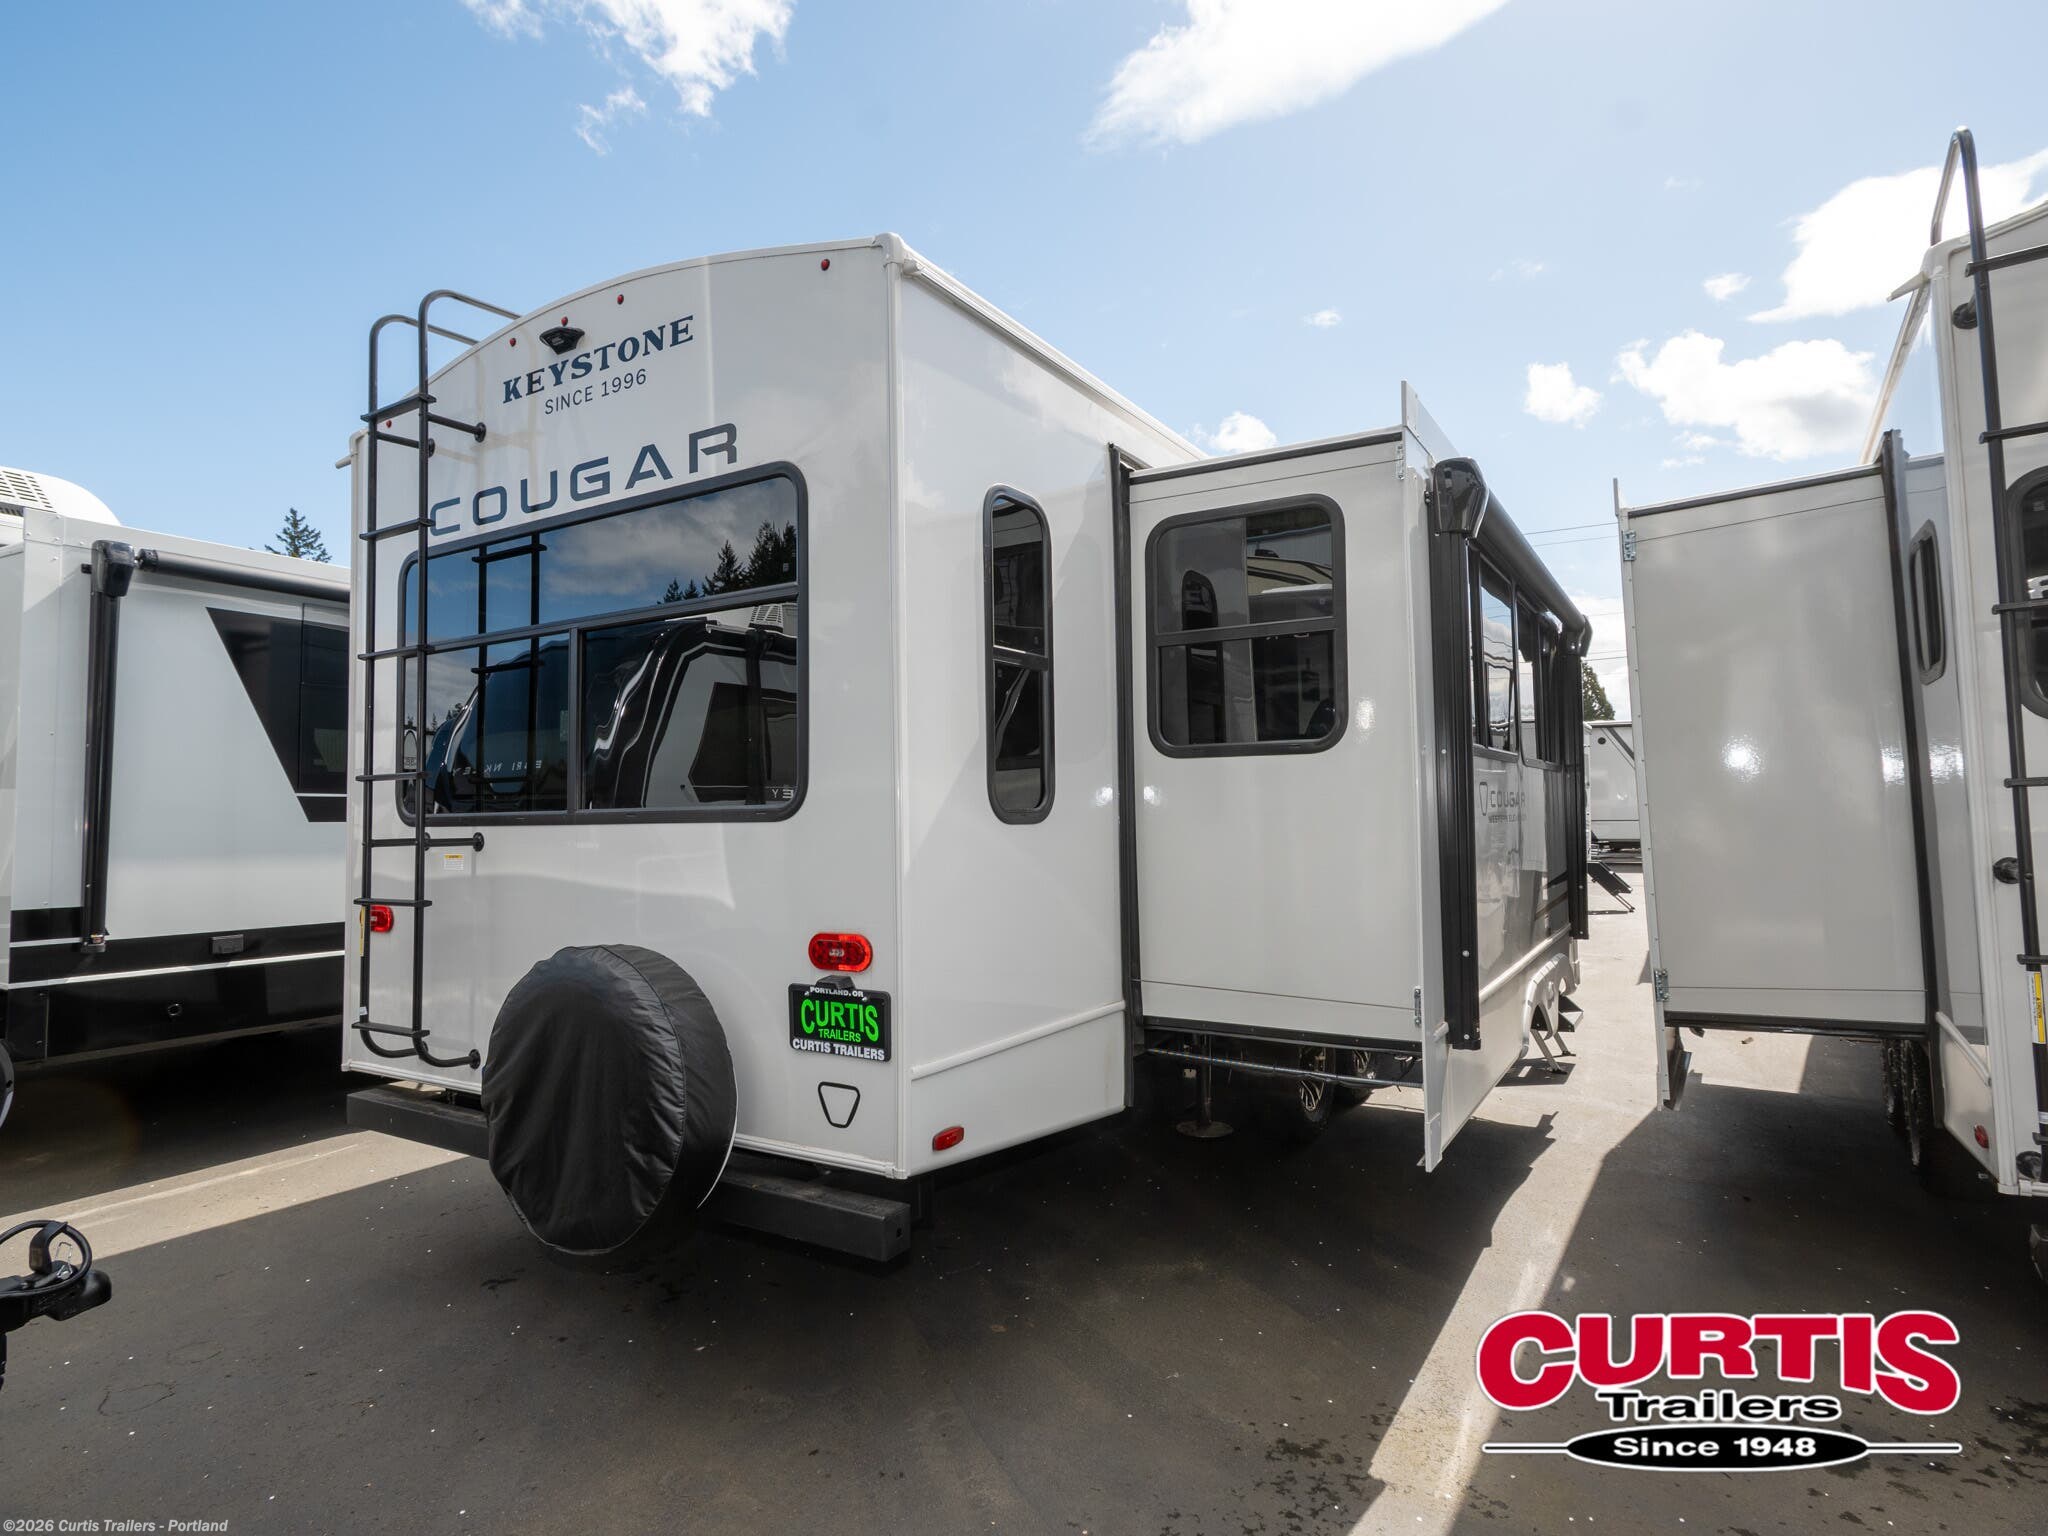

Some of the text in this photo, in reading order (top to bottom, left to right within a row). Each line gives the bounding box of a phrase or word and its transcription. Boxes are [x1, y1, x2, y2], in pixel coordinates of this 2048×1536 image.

[502, 315, 694, 404] KEYSTONE
[544, 368, 647, 415] SINCE 1996
[430, 423, 737, 536] COUGAR
[1490, 791, 1526, 807] COUGAR
[801, 999, 879, 1041] CURTIS
[818, 1028, 861, 1043] TRAILERS
[792, 1038, 885, 1061] CURTIS TRAILERS
